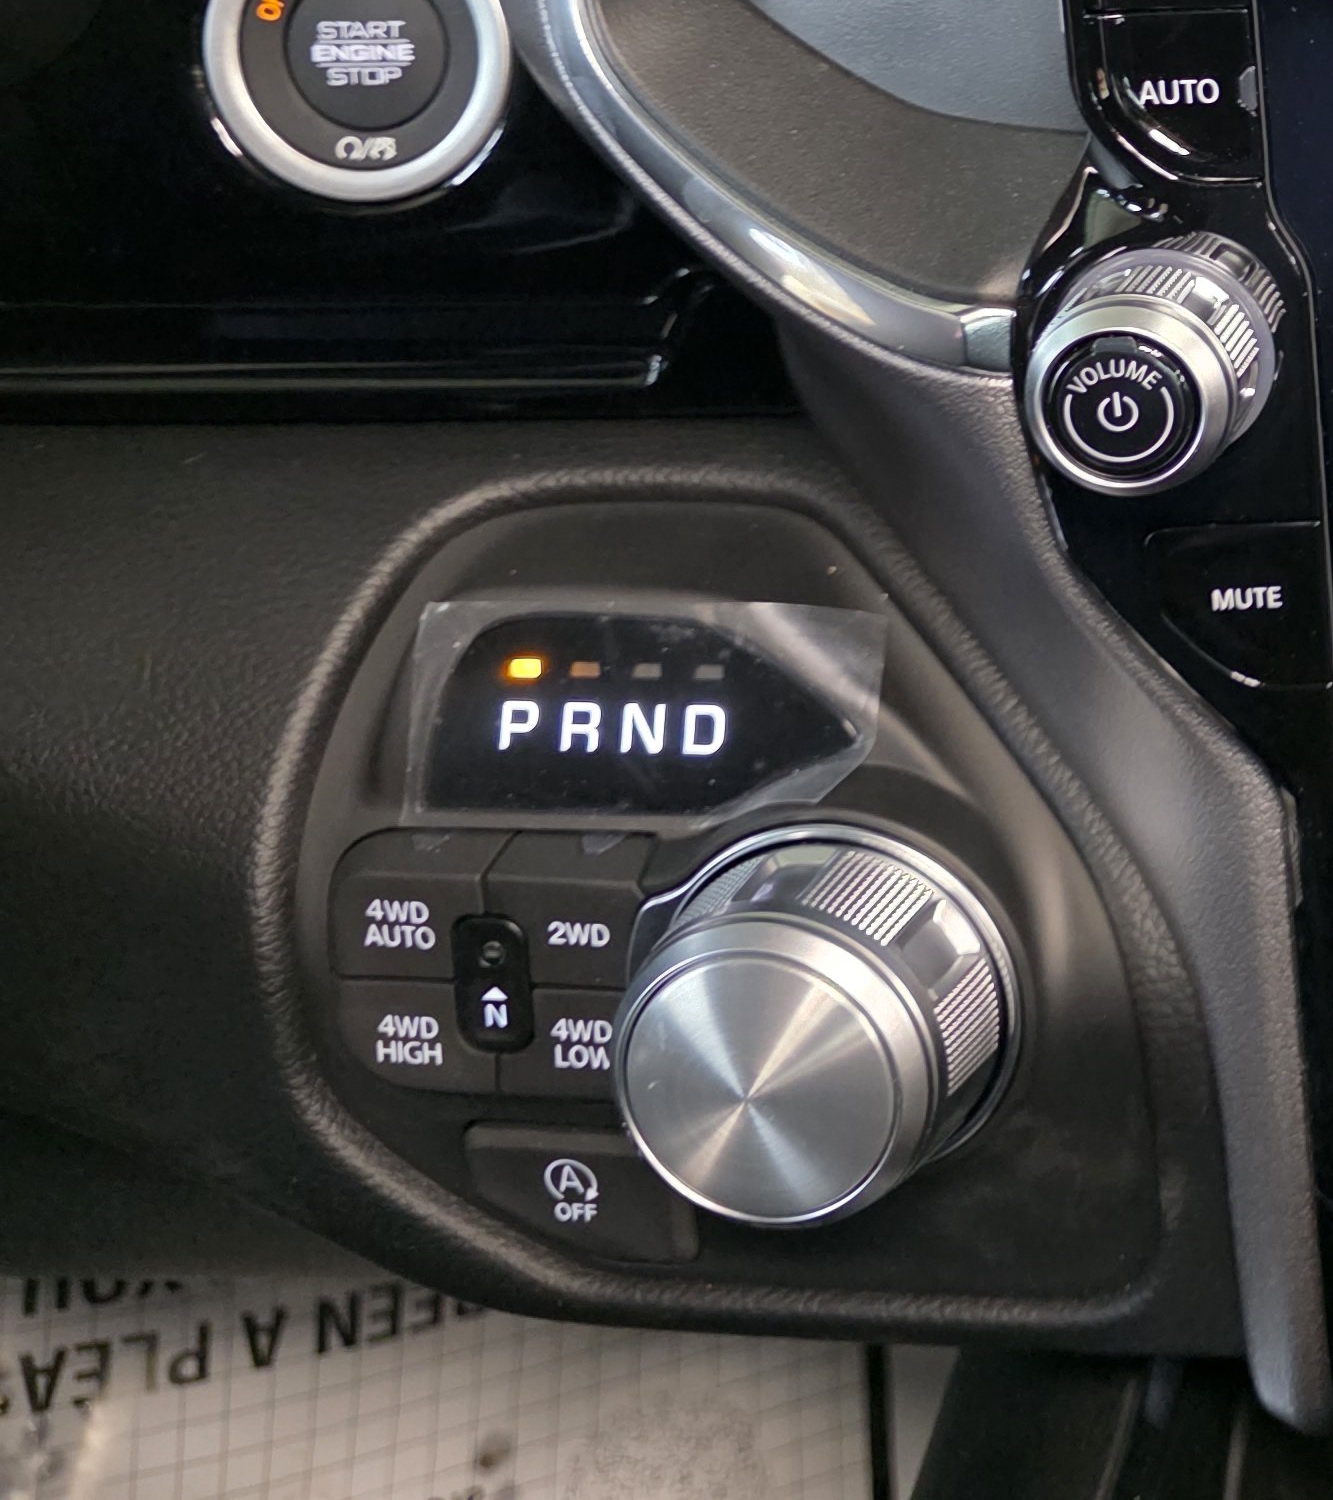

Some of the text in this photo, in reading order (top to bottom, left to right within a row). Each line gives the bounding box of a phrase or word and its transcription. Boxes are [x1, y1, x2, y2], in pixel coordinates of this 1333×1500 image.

[316, 20, 406, 40] START
[309, 43, 416, 63] ENGINE
[326, 65, 403, 87] STOP
[1139, 78, 1220, 105] AUTO
[1065, 357, 1164, 394] VOLUME
[1211, 585, 1283, 611] MUTE
[365, 899, 430, 924] 4WD
[364, 925, 436, 951] AUTO
[547, 921, 611, 948] 2WD
[377, 1014, 440, 1040] 4WD
[484, 1003, 508, 1029] N
[550, 1018, 613, 1044] 4WD
[375, 1040, 443, 1066] HIGH
[554, 1202, 598, 1222] OFF
[315, 1280, 490, 1356] EEN
[0, 1320, 213, 1414] PLEA
